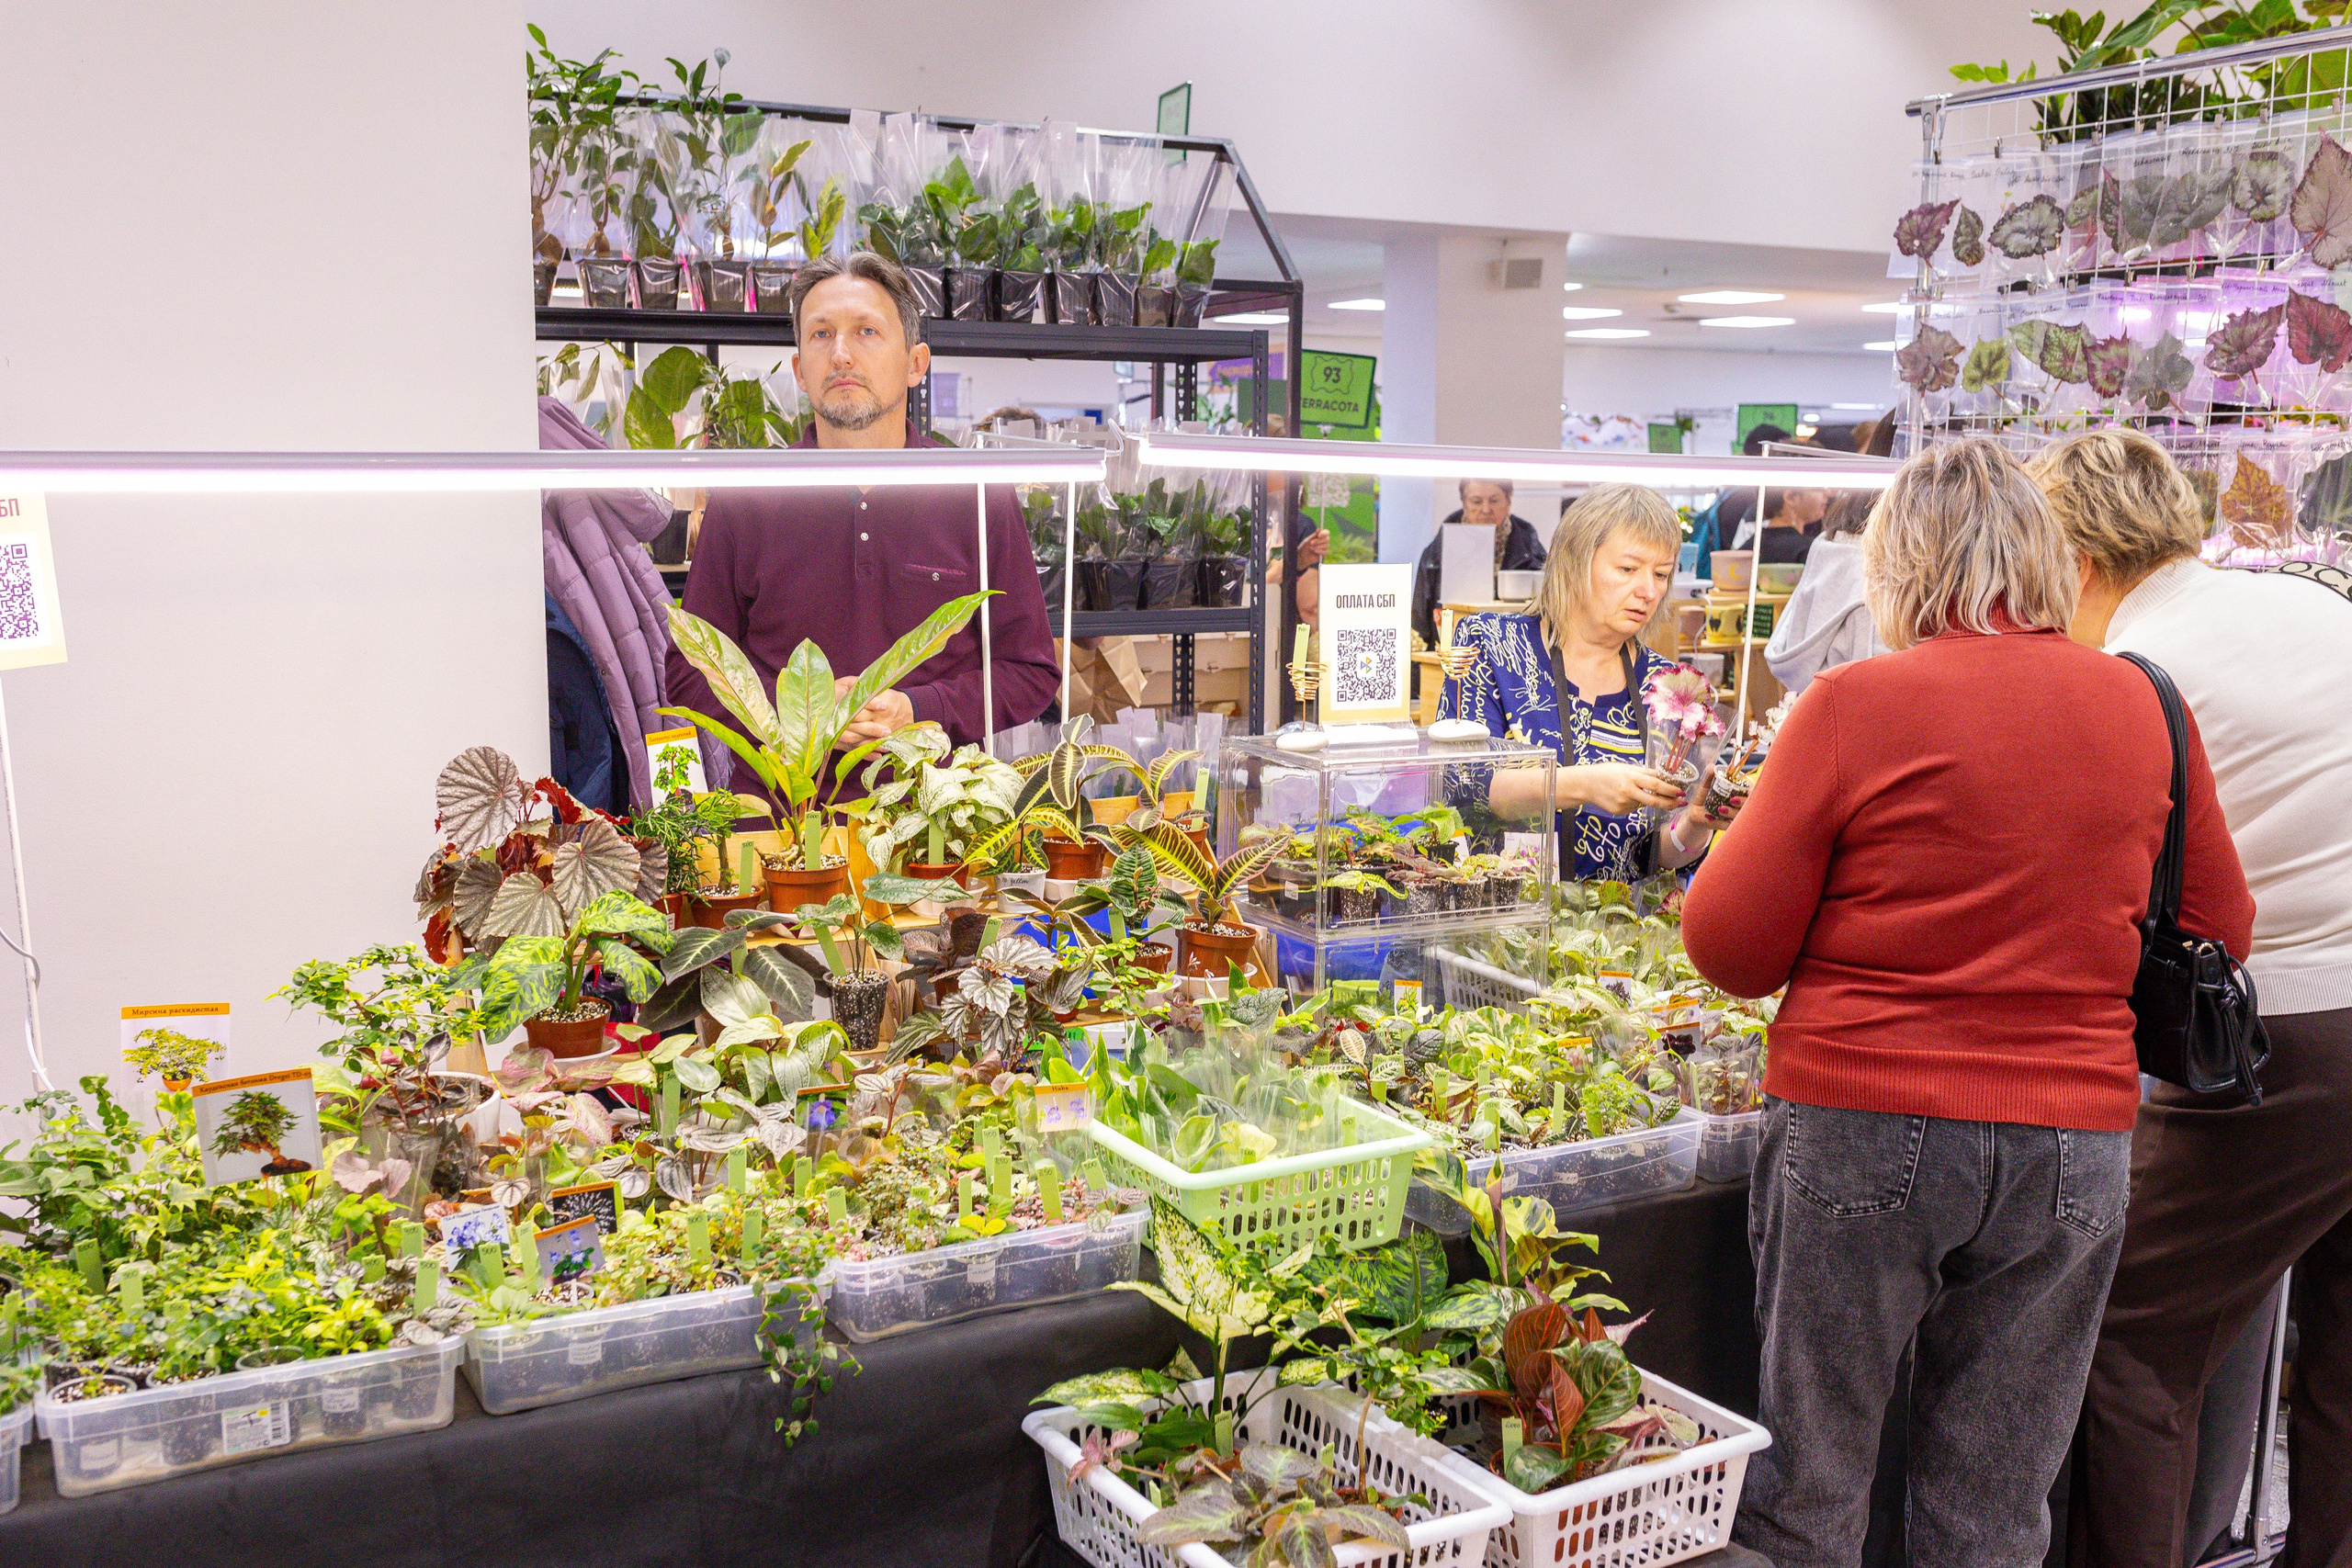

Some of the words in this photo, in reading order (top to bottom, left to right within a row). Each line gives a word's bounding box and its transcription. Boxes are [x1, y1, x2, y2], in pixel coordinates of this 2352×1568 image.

[1323, 366, 1341, 384] 93
[1301, 397, 1360, 413] ERRACOTA
[0, 498, 20, 518] БП
[1336, 594, 1374, 608] ОПЛАТА
[1376, 593, 1396, 608] СБП
[131, 1008, 167, 1017] Мирсина
